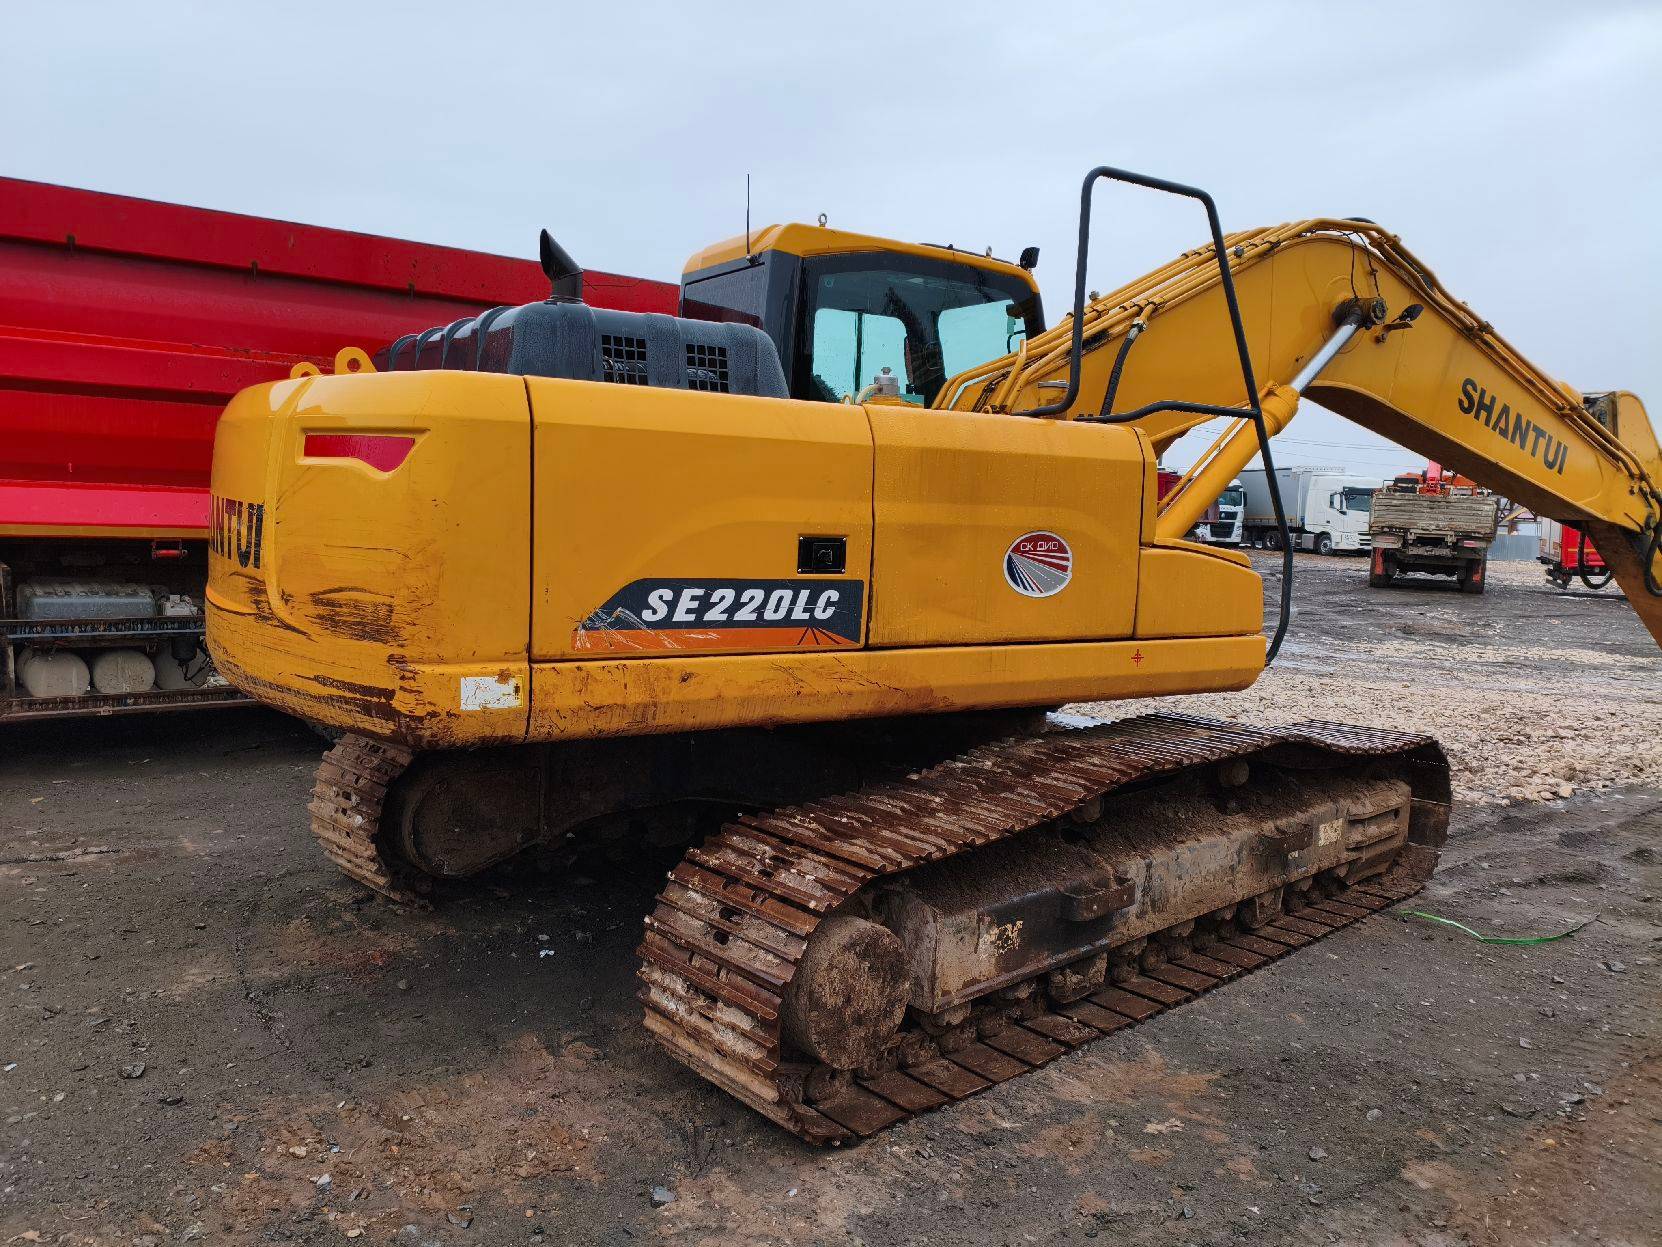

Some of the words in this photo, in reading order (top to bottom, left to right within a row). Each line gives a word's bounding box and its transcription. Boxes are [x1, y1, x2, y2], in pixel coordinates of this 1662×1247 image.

[1458, 378, 1569, 475] SHANTUI
[1020, 542, 1034, 551] СК
[1036, 541, 1059, 551] ДИО
[641, 588, 839, 622] SE220LC
